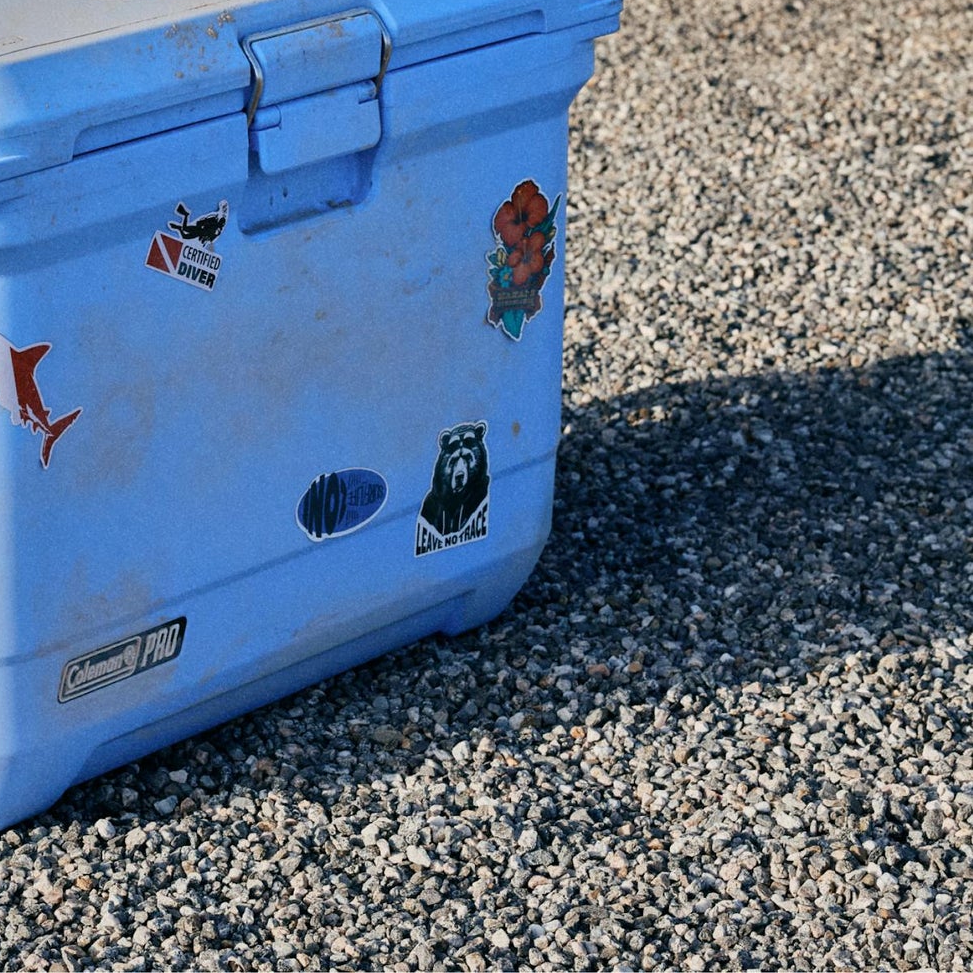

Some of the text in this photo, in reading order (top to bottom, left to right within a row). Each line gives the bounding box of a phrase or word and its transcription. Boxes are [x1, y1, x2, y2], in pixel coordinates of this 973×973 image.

[177, 261, 216, 289] DIVER
[182, 245, 221, 271] CERTIFIED
[415, 503, 488, 556] LEAVE NO TRACE
[67, 623, 180, 689] Coleman PRO
